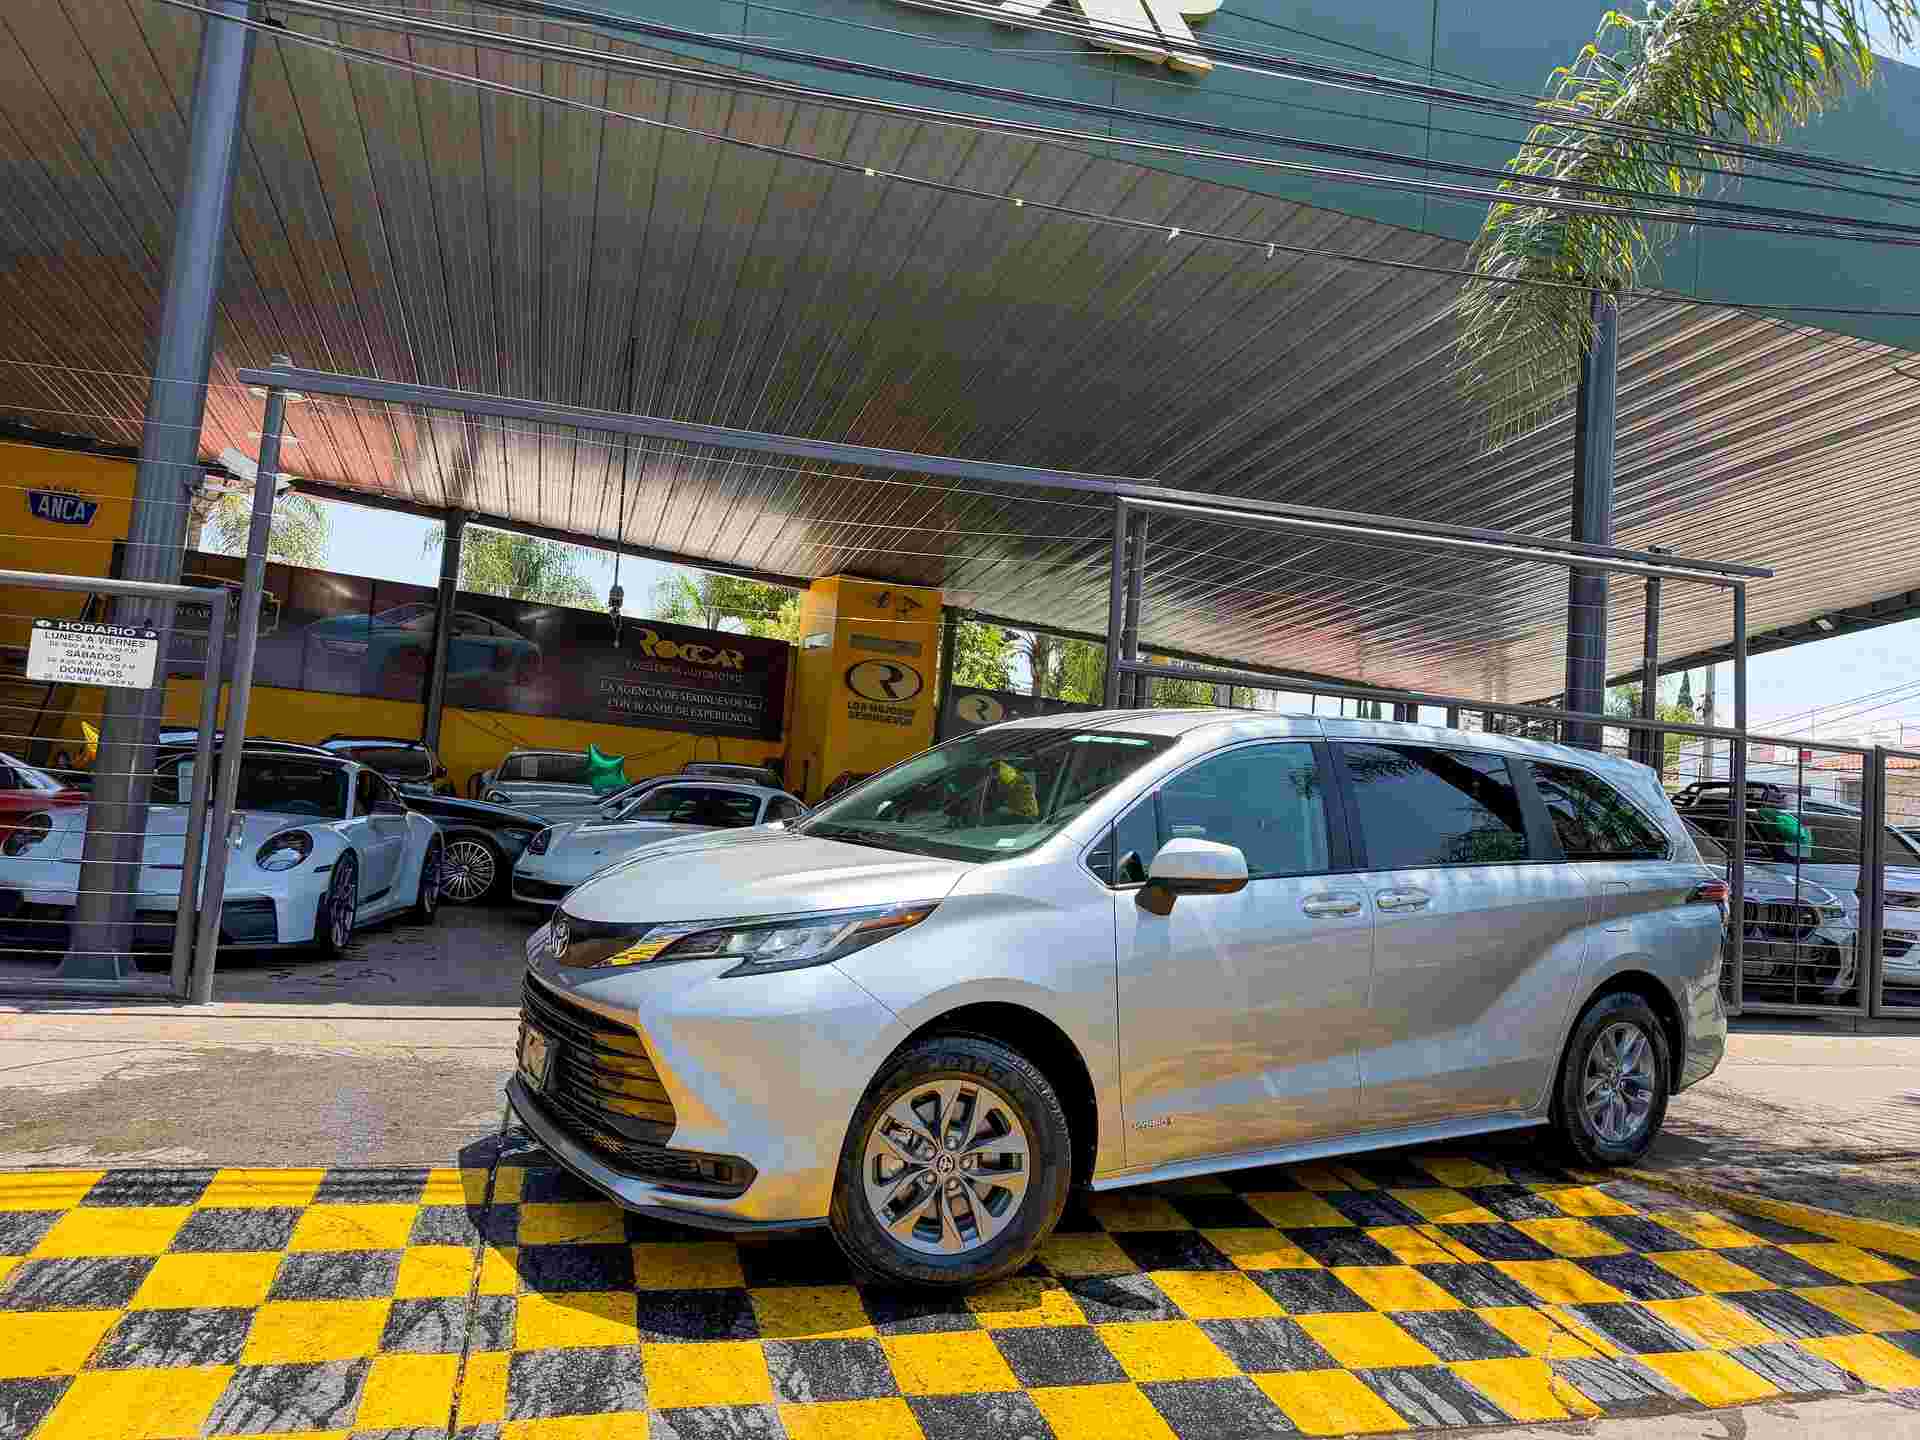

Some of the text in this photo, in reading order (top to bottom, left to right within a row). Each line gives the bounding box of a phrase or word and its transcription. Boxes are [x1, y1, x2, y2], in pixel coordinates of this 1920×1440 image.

[39, 496, 86, 521] ANCA
[58, 622, 136, 637] HORARIO
[44, 631, 146, 648] LUNES A VIERNES
[60, 664, 123, 679] DOMINGOS
